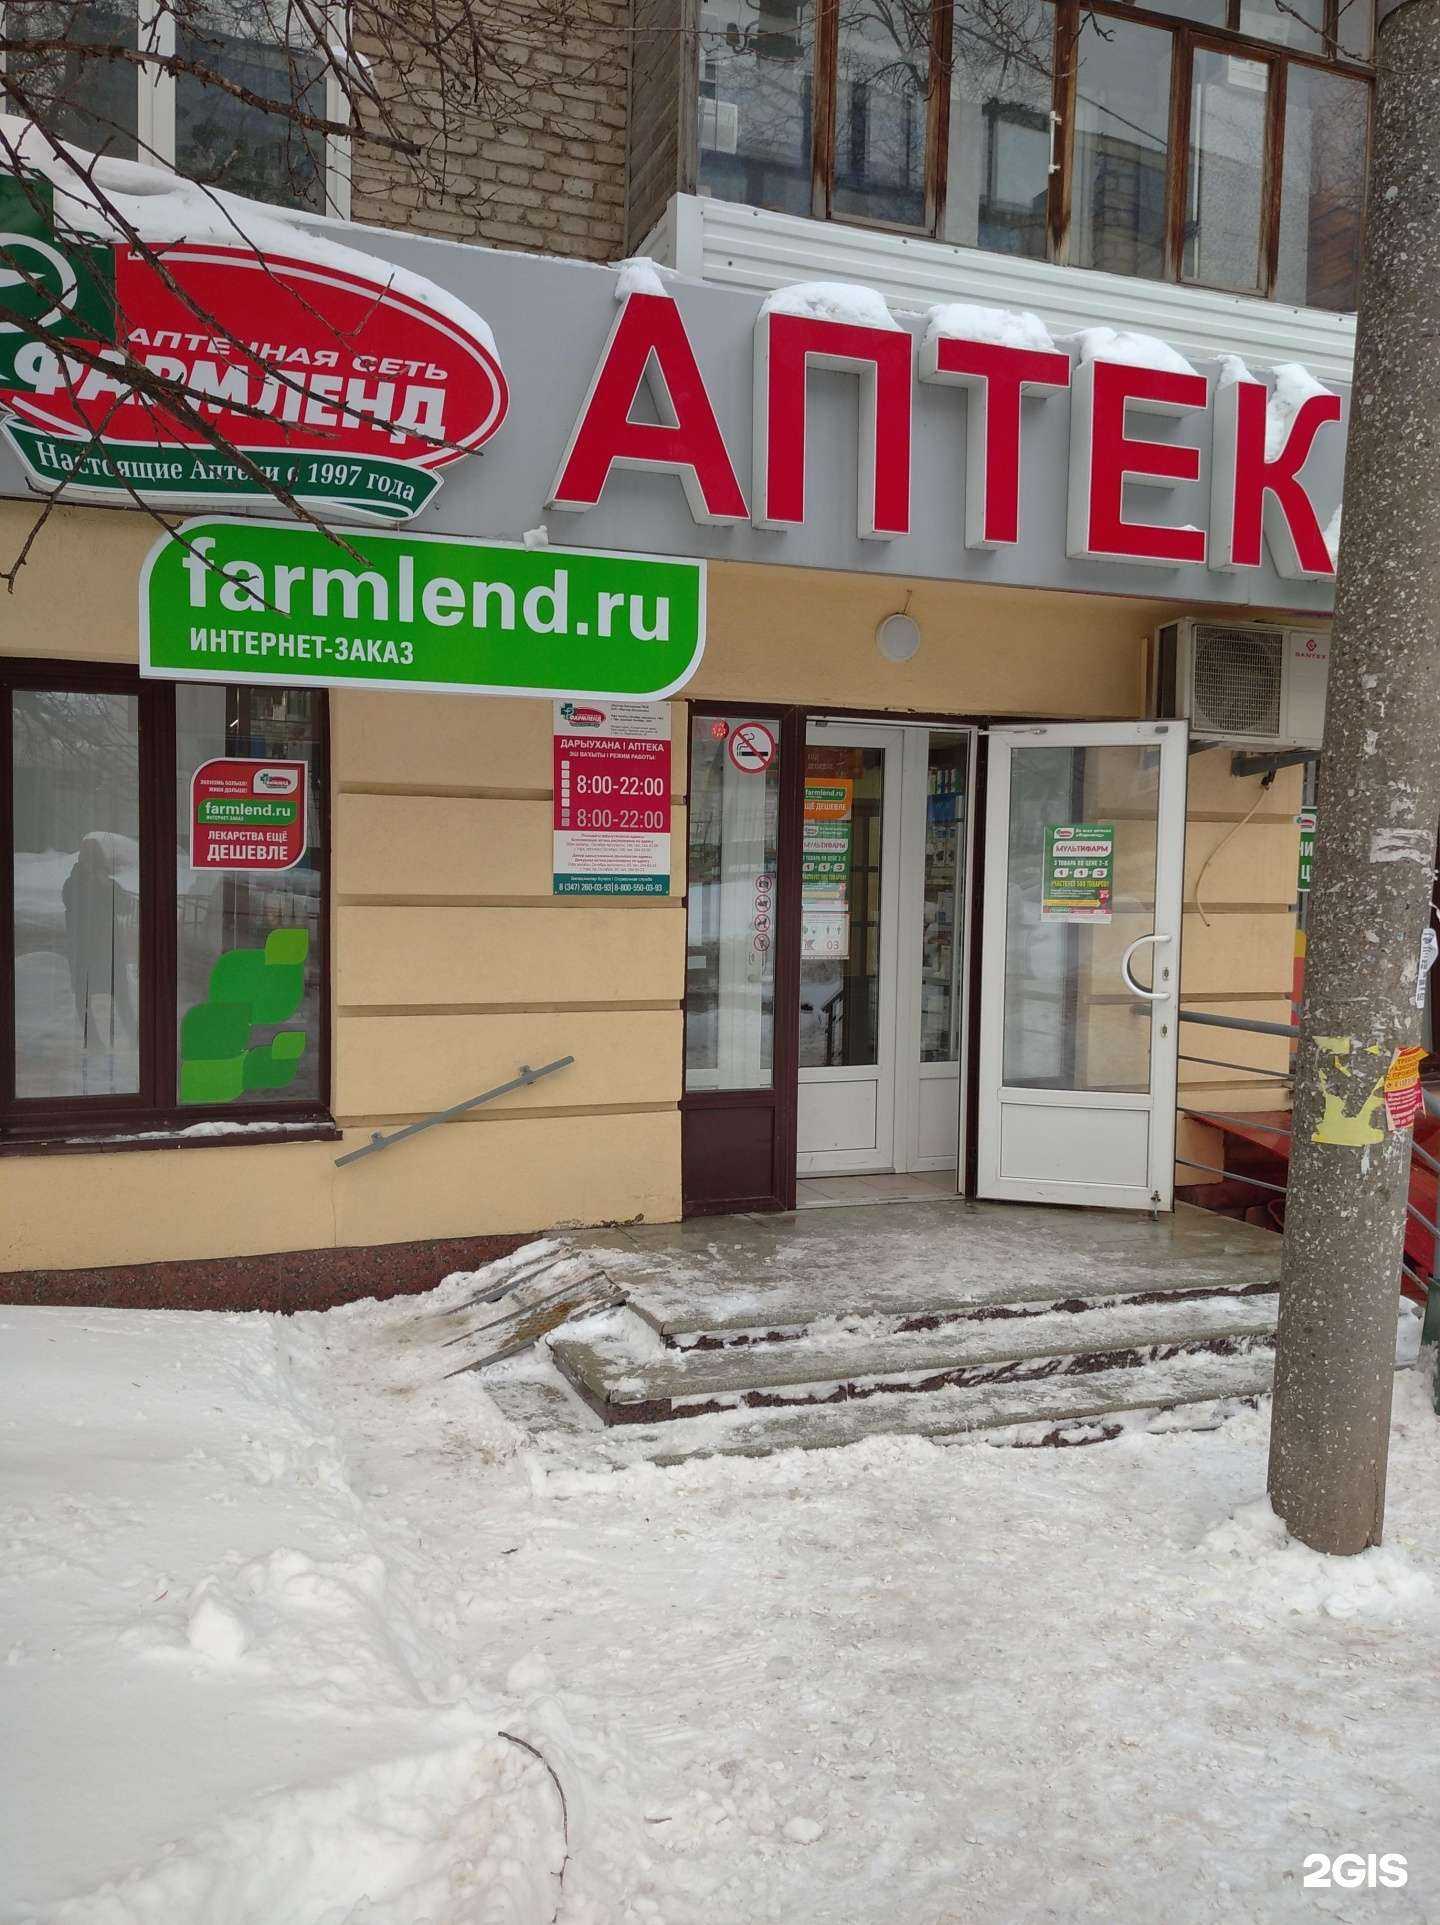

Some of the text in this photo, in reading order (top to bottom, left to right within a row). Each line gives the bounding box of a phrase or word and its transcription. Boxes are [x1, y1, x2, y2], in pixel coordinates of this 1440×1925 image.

[351, 355, 448, 381] СЕТЬ
[14, 342, 446, 448] ФАРМЛЕНД
[549, 291, 1342, 577] АПТЕК
[35, 441, 183, 482] Настоящие
[190, 460, 278, 481] Аптеи
[308, 463, 363, 486] 1997
[366, 472, 415, 501] года
[182, 536, 670, 642] farmlend.ru
[190, 627, 415, 665] ИНТЕРНЕТ-ЗАКАЗ
[628, 743, 665, 752] АПТЕКА
[577, 775, 664, 796] 8:00-22:00
[205, 802, 291, 817] farmlend.ru
[577, 809, 664, 829] 8:00-22:00
[207, 830, 289, 843] ЛЕКАРСТВА ЕЩЁ
[207, 844, 289, 862] ДЕШЕВЛЕ
